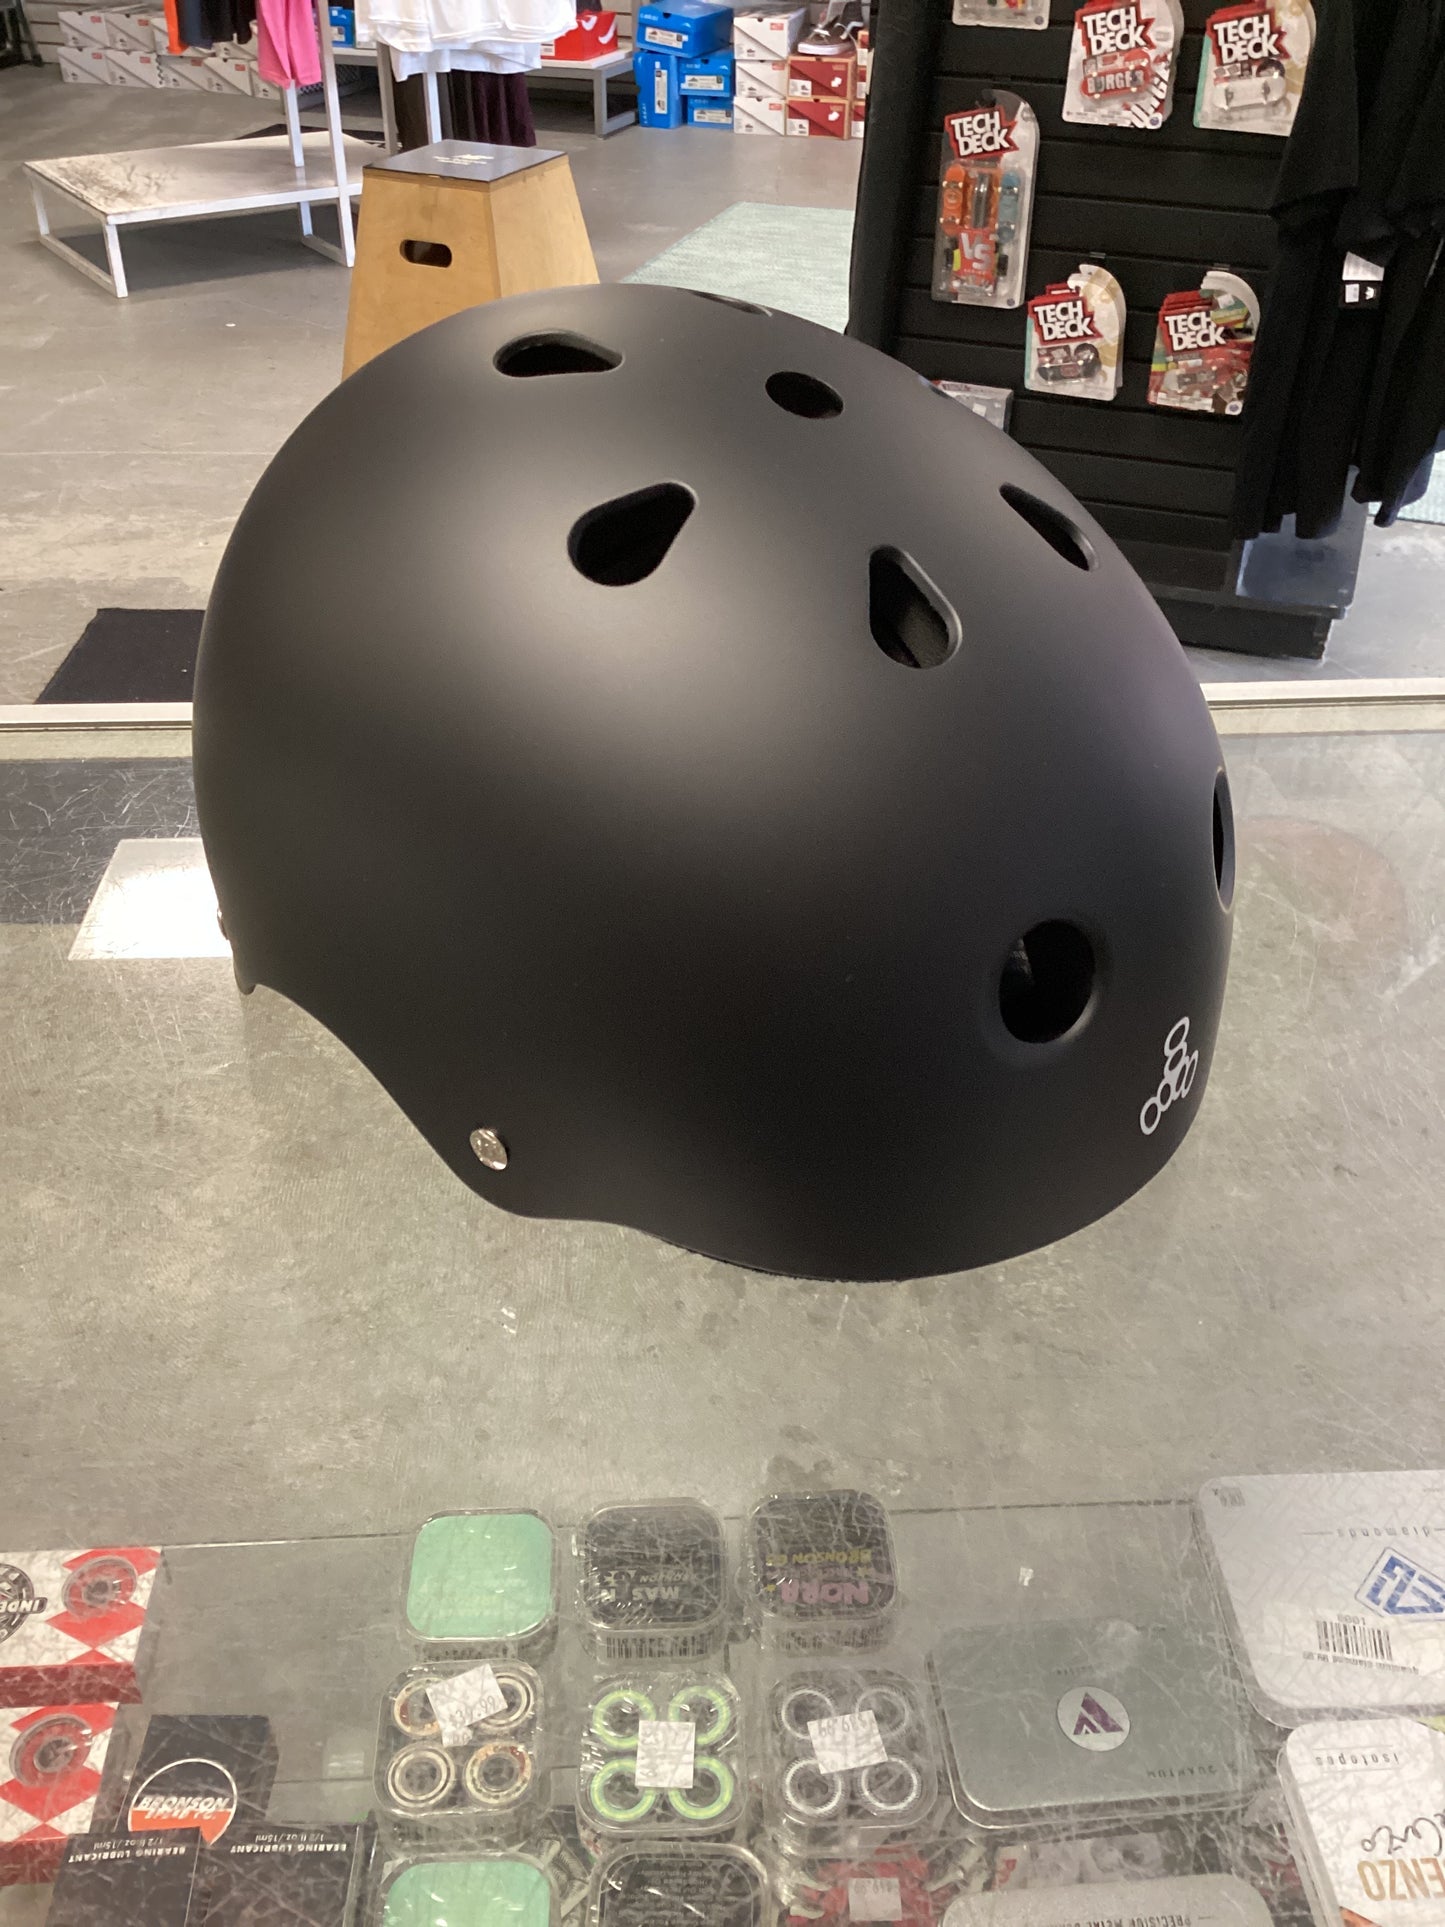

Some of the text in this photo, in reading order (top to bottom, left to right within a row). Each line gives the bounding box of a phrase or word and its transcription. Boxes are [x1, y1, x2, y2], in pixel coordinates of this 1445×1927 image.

[1082, 6, 1137, 38] TECH
[1213, 15, 1270, 46] TECH
[1089, 25, 1147, 56] DECK
[1220, 33, 1280, 64] DECK
[950, 111, 1002, 140] TECH
[957, 128, 1010, 157] DECK
[1034, 300, 1084, 325] TECH
[1165, 311, 1216, 336] TECH
[1042, 317, 1095, 341] DECK
[1170, 327, 1227, 351] DECK
[781, 1580, 870, 1605] NORA
[1315, 1753, 1399, 1768] isotopes
[138, 1796, 230, 1809] BRONSON
[68, 1845, 187, 1863] BEARING LUBRICANT
[230, 1844, 347, 1854] BEARING LUBRICANT
